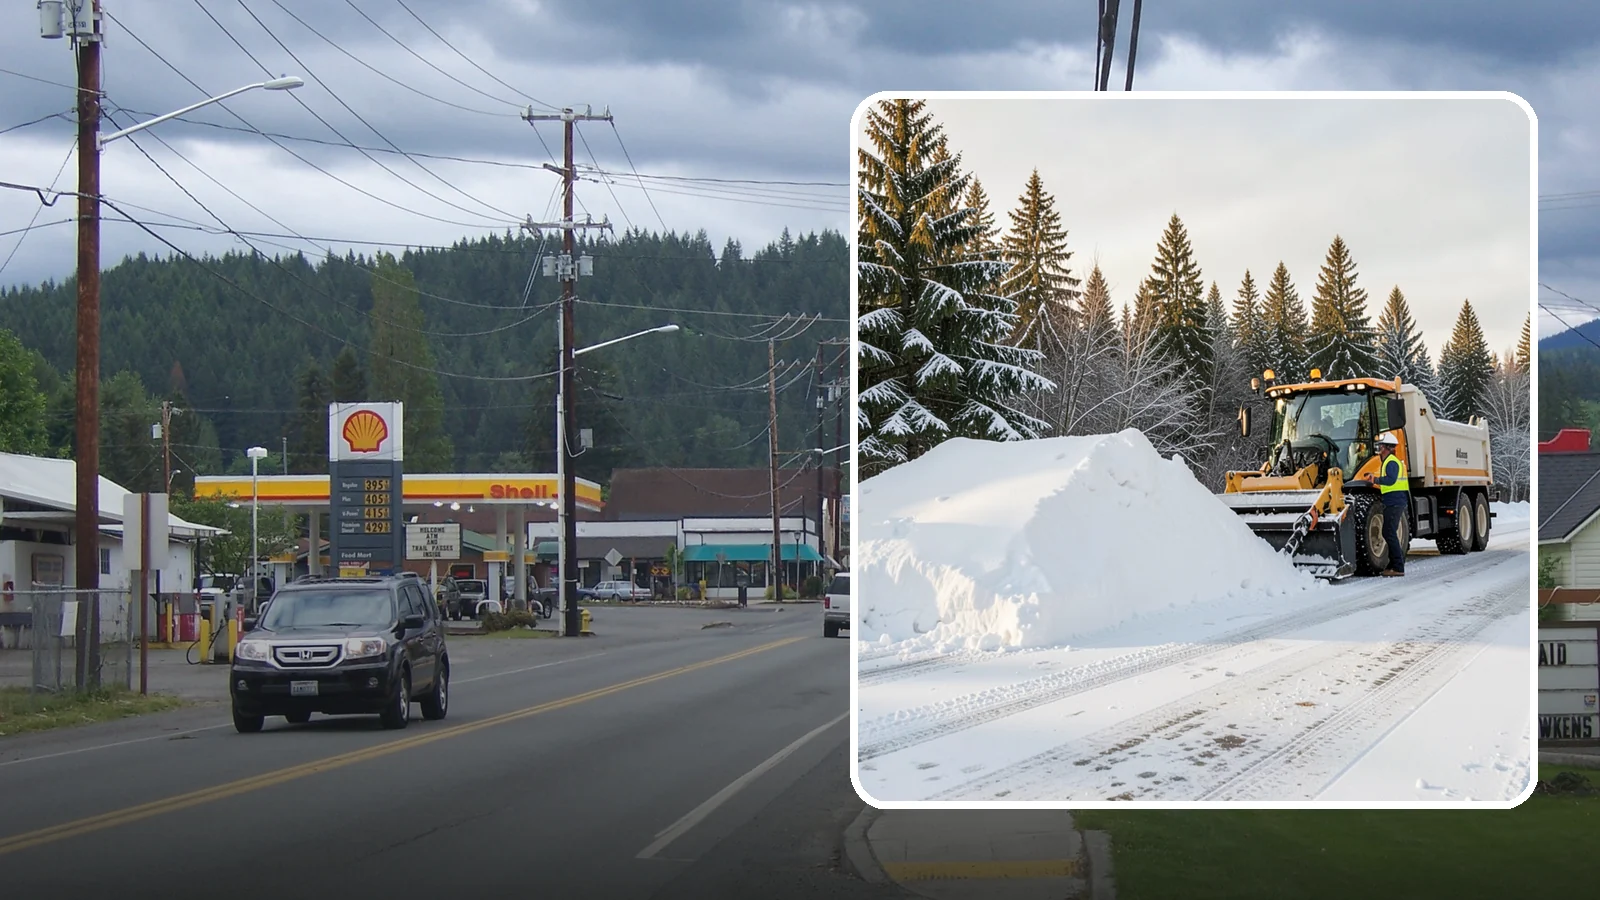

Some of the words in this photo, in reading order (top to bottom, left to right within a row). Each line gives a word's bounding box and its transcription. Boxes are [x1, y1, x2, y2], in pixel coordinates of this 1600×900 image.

[365, 480, 383, 490] 395
[489, 484, 547, 499] Shell
[365, 494, 383, 504] 405
[365, 508, 383, 518] 415
[365, 522, 383, 533] 429
